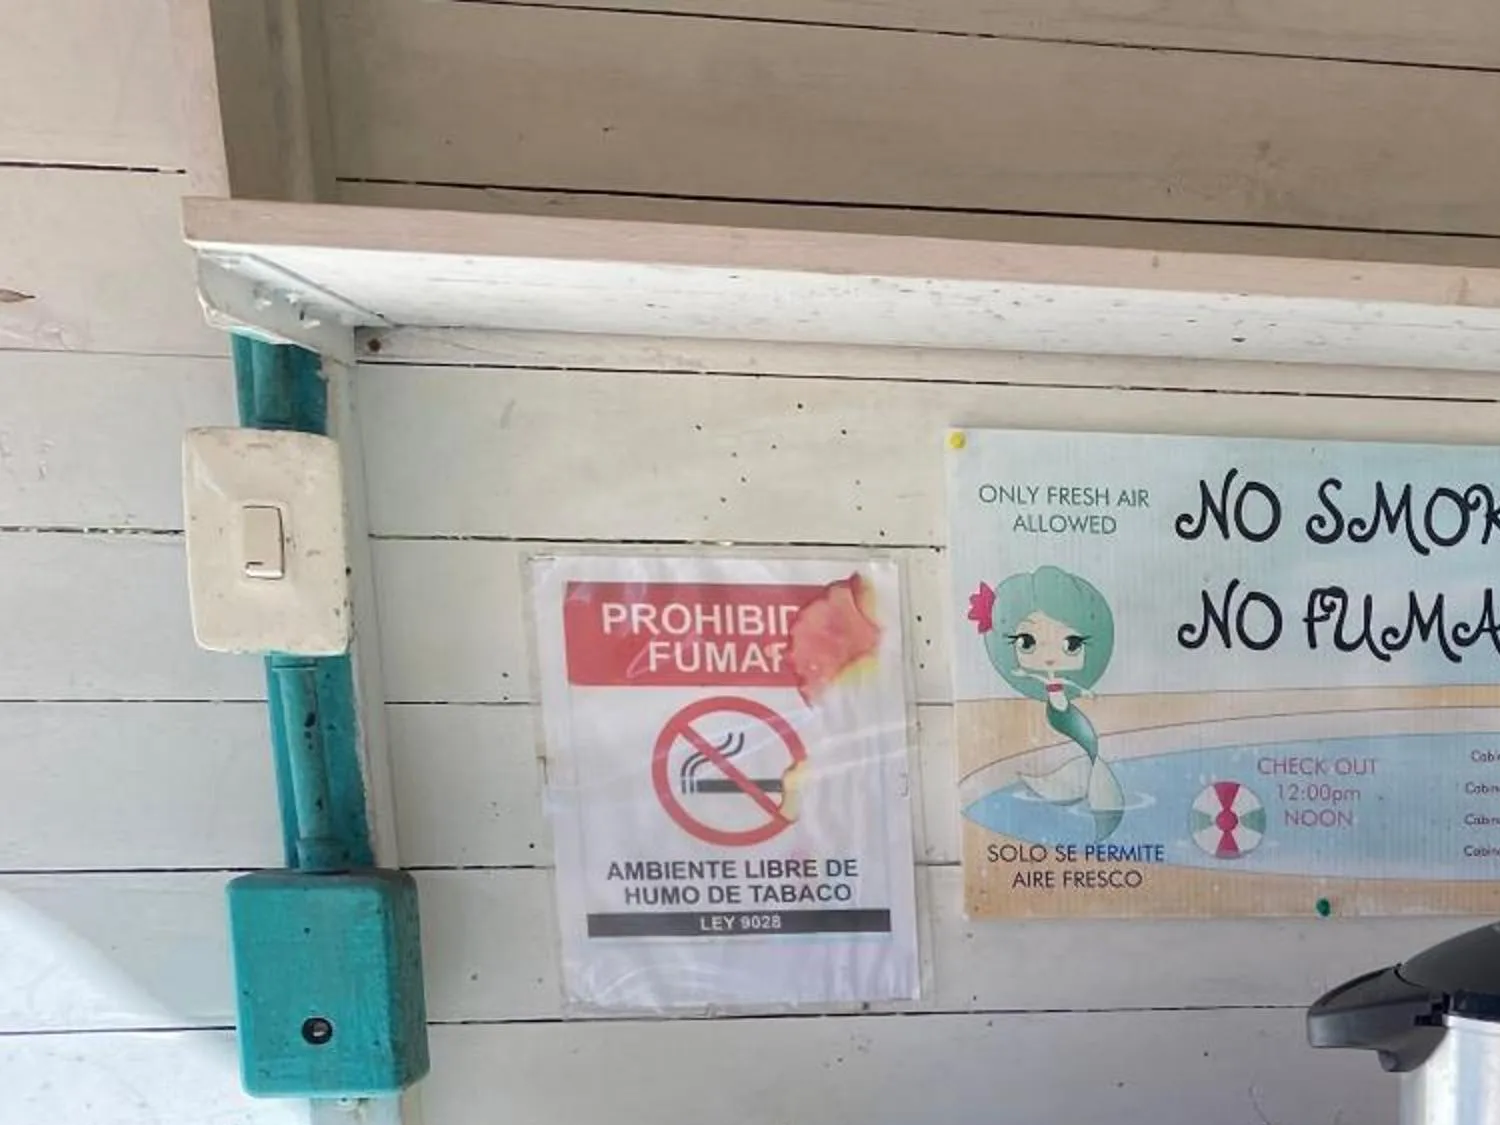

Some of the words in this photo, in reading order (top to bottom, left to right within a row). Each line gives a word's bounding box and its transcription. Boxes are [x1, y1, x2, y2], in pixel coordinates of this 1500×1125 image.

[979, 485, 1039, 505] ONLY
[1047, 486, 1109, 507] FRESH
[1117, 489, 1150, 507] AIR
[1175, 468, 1282, 542] NO
[1013, 514, 1117, 535] ALLOWED
[602, 602, 800, 637] PROHIBI
[1177, 579, 1283, 651] NO
[1257, 756, 1327, 775] CHECK
[1334, 757, 1378, 776] OUT
[1278, 784, 1361, 804] 12:00pm
[1284, 808, 1354, 827] NOON
[987, 844, 1048, 862] SOLO
[1055, 845, 1077, 862] SE
[1085, 845, 1164, 862] PERMITE
[607, 860, 736, 881] AMBIENTE
[745, 859, 819, 878] LIBRE
[826, 859, 858, 877] DE
[1011, 871, 1055, 888] AIRE
[1063, 869, 1143, 888] FRESCO
[624, 885, 700, 905] HUMO
[708, 885, 741, 903] DE
[747, 883, 852, 903] TABACO
[700, 916, 735, 931] LEY
[740, 915, 782, 930] 9028
